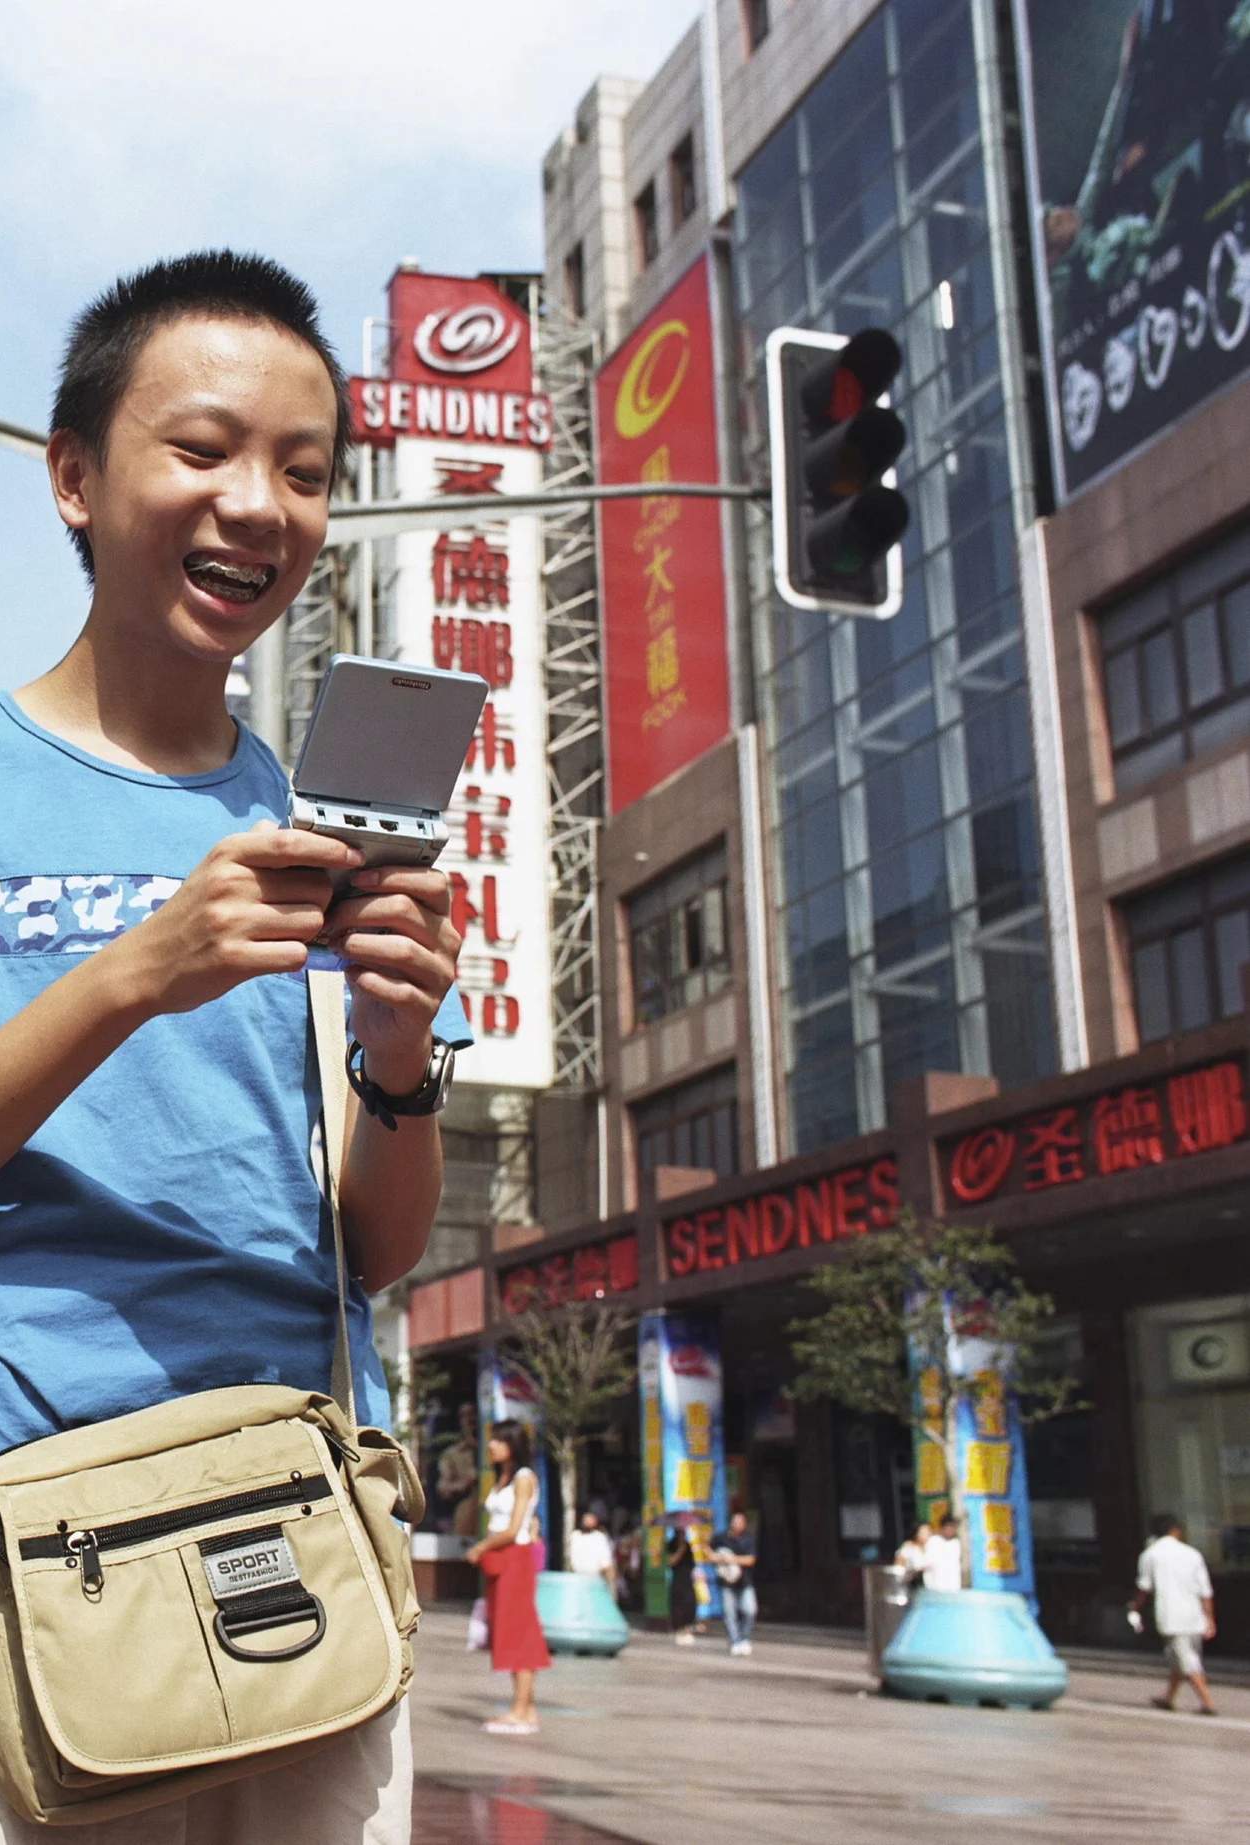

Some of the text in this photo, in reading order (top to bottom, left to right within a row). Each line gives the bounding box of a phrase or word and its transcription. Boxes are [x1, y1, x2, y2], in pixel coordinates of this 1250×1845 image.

[360, 382, 550, 445] SENDNES
[670, 1159, 900, 1276] SENDNES
[217, 1548, 279, 1575] SPORT
